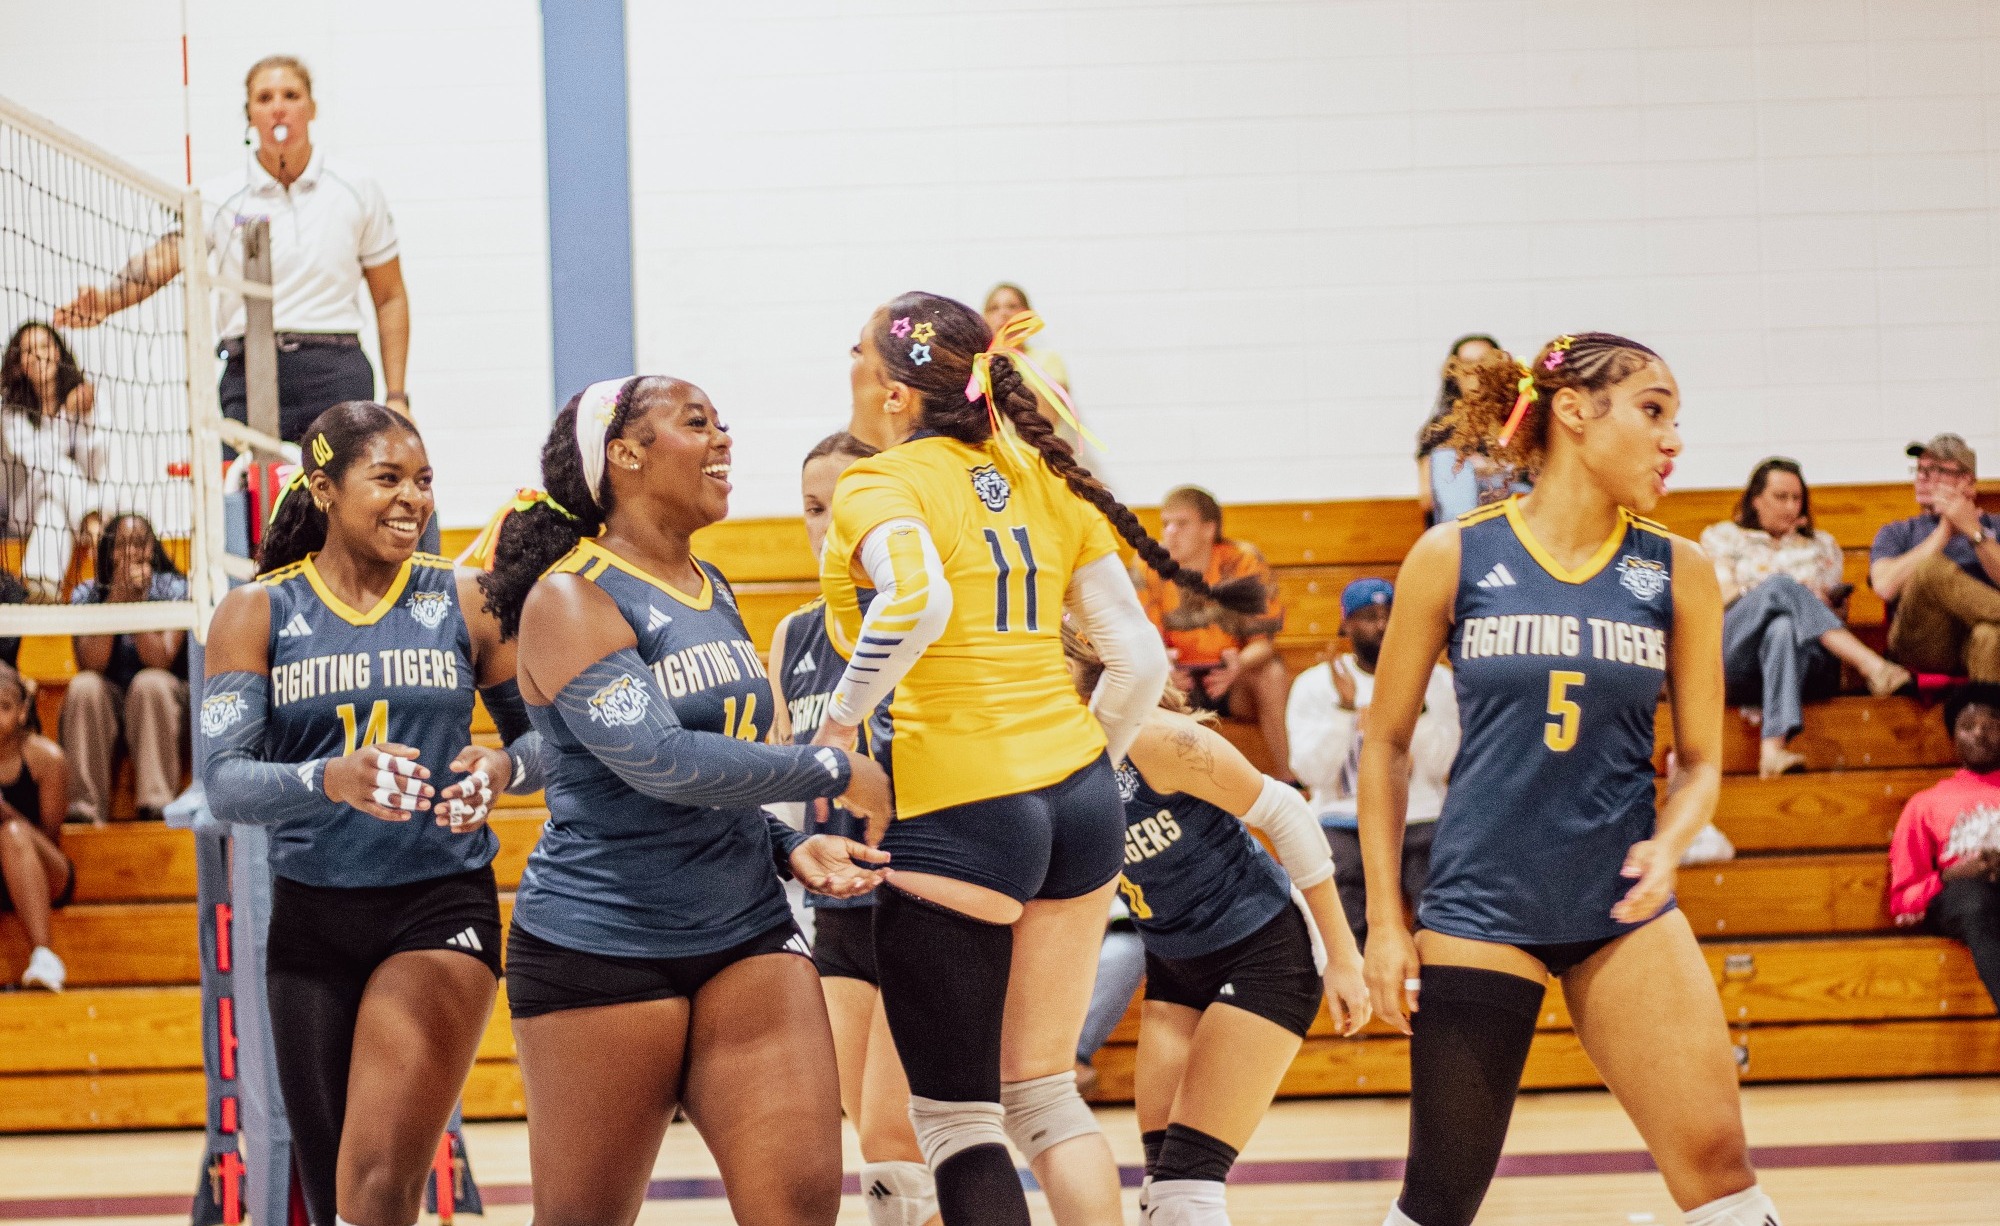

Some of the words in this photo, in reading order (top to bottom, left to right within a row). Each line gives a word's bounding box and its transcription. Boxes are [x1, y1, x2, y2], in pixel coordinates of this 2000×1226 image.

[982, 526, 1038, 632] 11
[649, 640, 741, 700] IGHTING
[1461, 615, 1580, 659] FIGHTING
[1587, 618, 1666, 671] TIGERS
[271, 652, 371, 707] FIGHTING
[379, 649, 458, 690] TIGERS
[336, 699, 389, 757] 14
[723, 693, 758, 742] 16
[1543, 670, 1586, 752] 5
[1125, 809, 1182, 865] GERS
